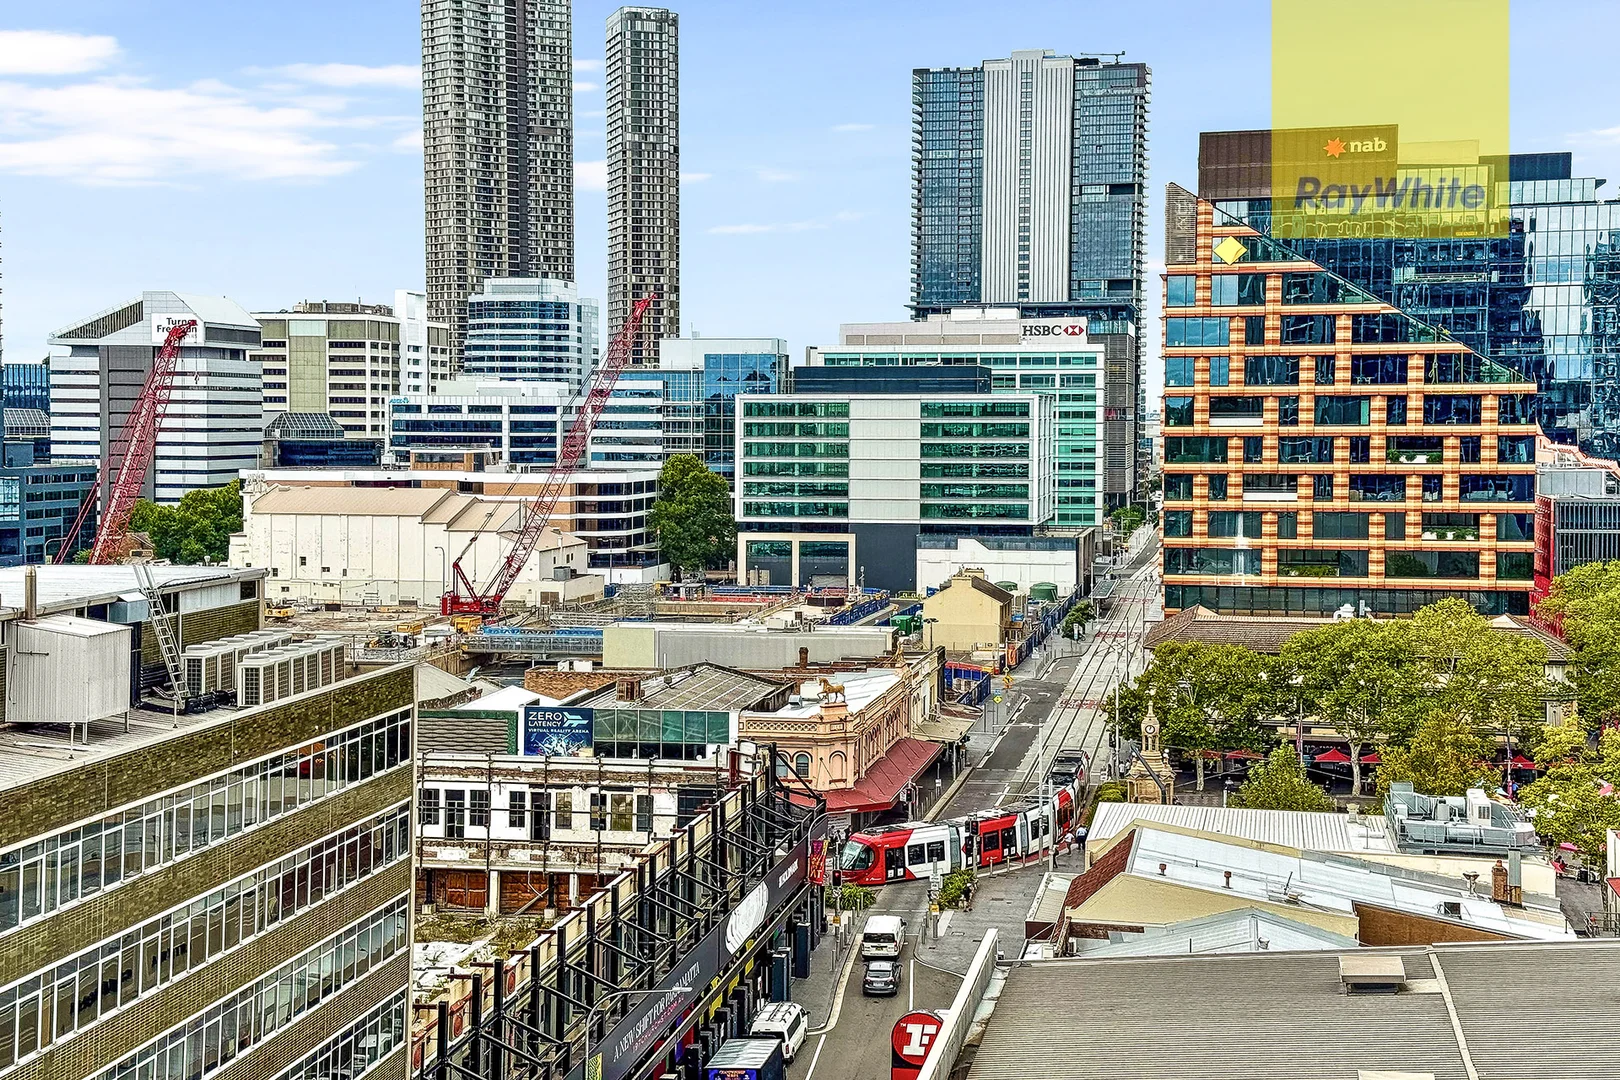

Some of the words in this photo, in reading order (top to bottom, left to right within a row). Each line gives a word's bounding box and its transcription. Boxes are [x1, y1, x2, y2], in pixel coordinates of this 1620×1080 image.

[1350, 137, 1387, 153] nab
[166, 317, 197, 326] Turn
[156, 324, 198, 333] Frean
[1021, 324, 1062, 337] HSBC
[528, 711, 562, 721] ZERO
